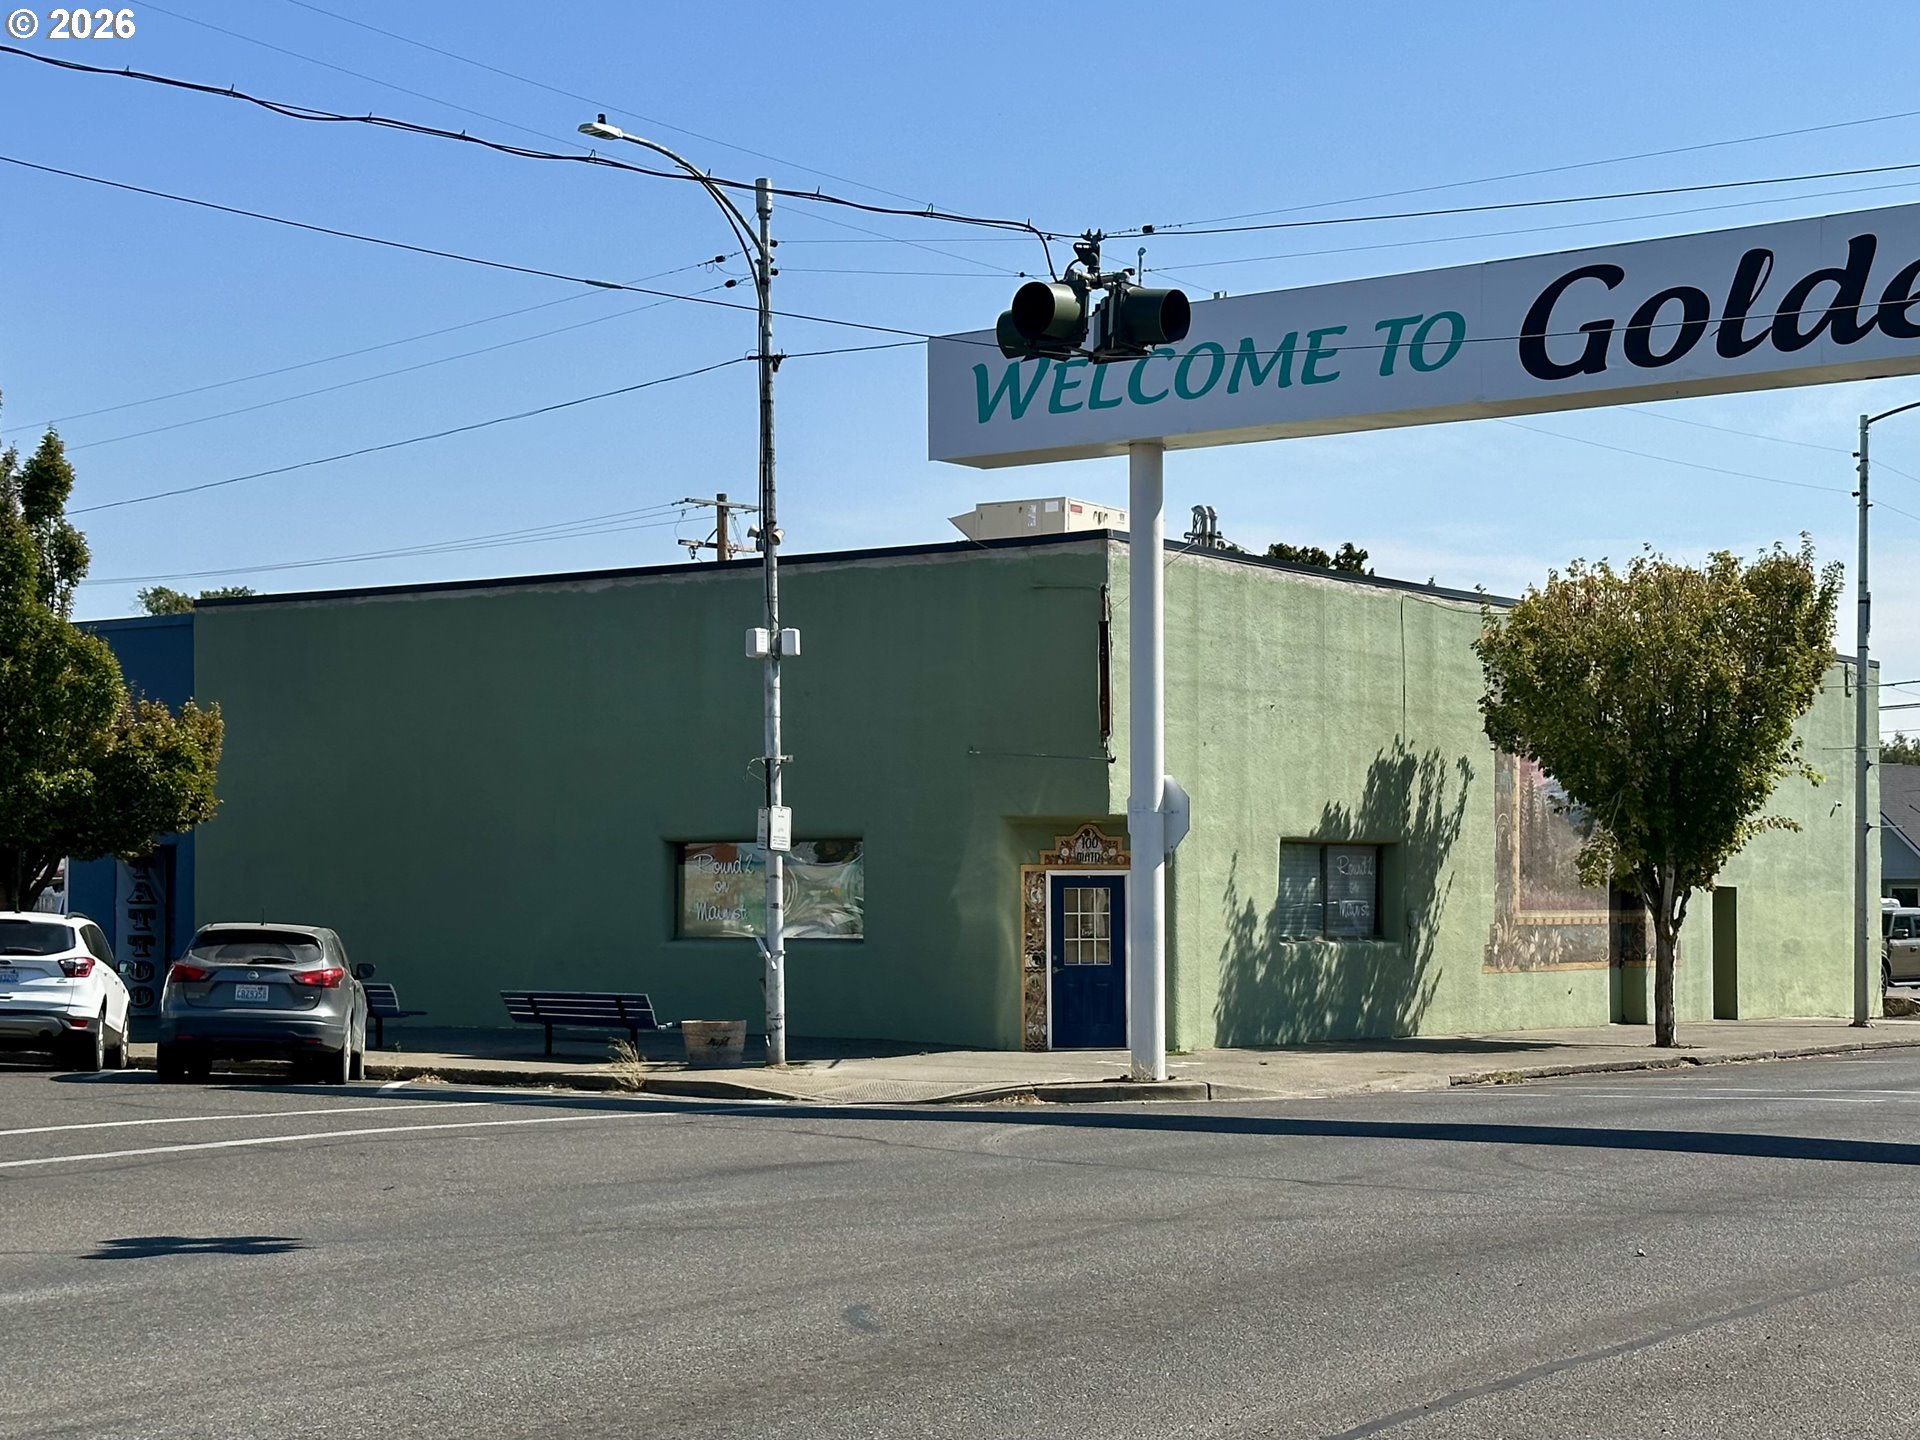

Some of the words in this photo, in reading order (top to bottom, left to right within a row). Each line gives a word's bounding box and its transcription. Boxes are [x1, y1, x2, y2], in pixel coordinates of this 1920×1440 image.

[972, 325, 1348, 424] WELCOME
[1374, 311, 1467, 377] TO
[1518, 233, 1920, 381] Golde
[1081, 837, 1099, 849] 100
[693, 853, 742, 874] Round
[744, 854, 754, 874] 2
[714, 881, 729, 893] on
[126, 858, 158, 1009] TATTOO
